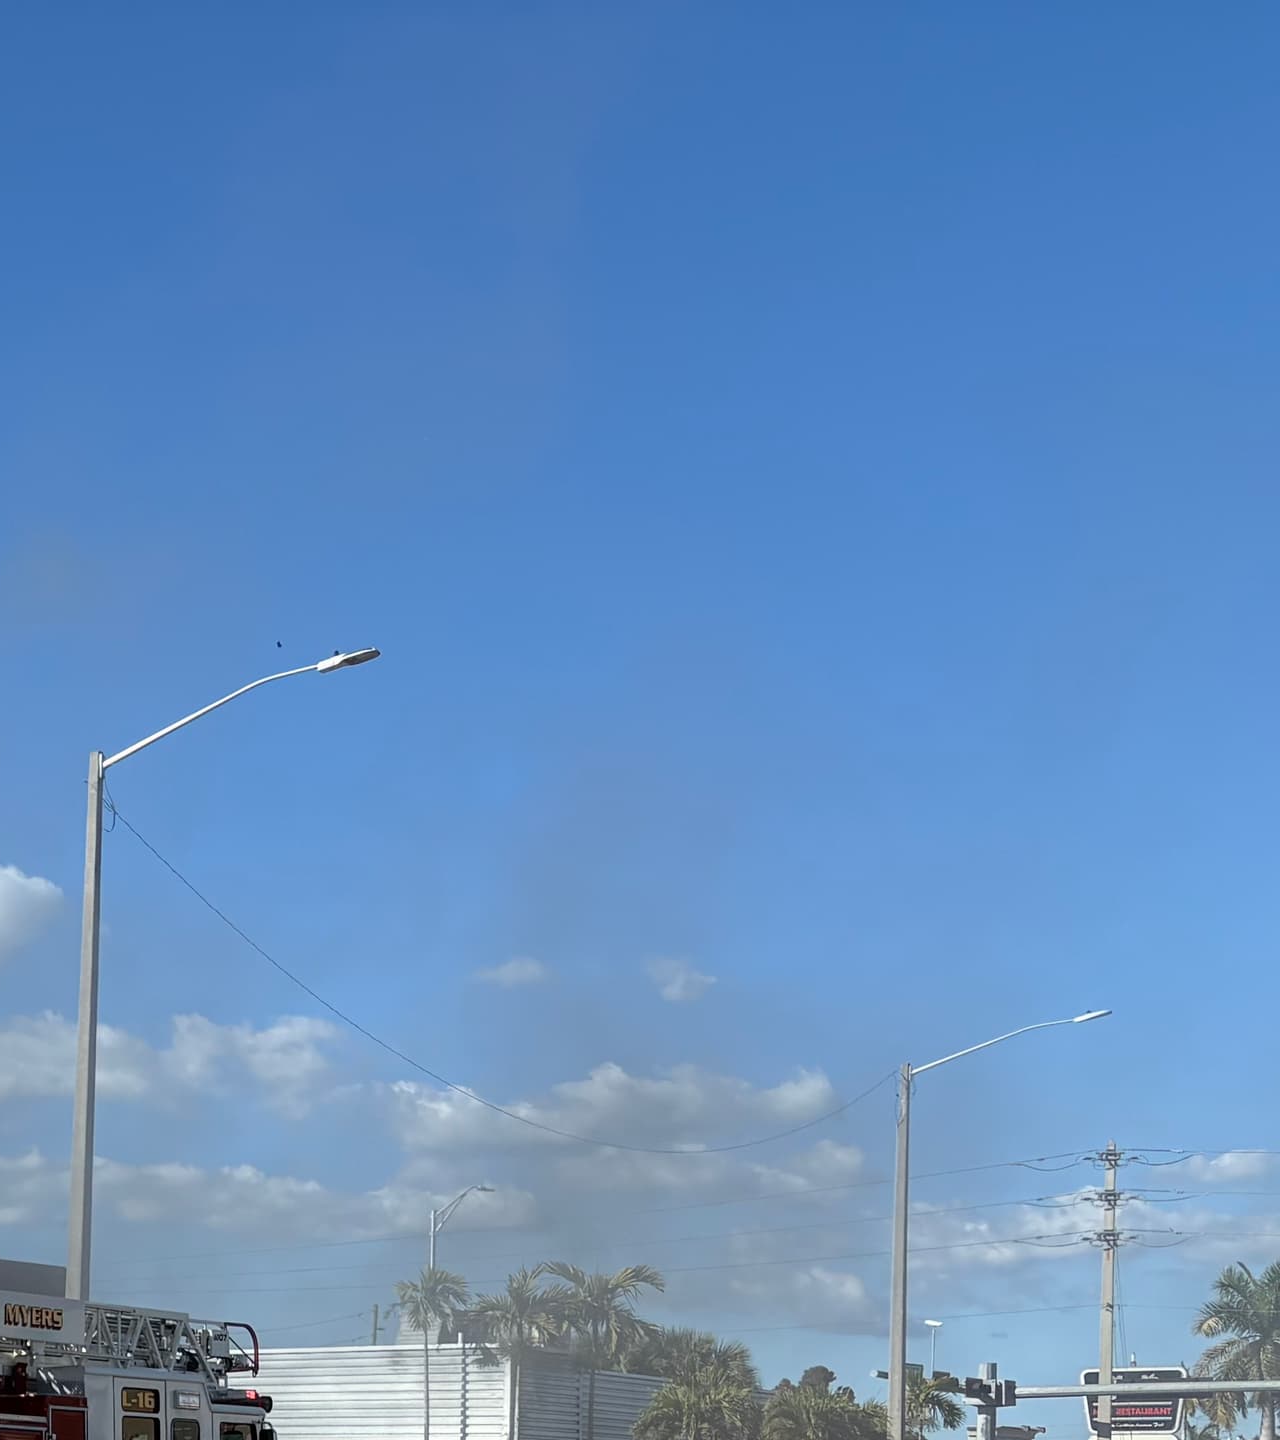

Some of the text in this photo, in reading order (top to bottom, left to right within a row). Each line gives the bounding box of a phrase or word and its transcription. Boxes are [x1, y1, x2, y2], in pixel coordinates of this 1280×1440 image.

[4, 1303, 64, 1331] MYERS
[123, 1390, 155, 1409] L-16
[1116, 1407, 1172, 1416] RESTAURANT
